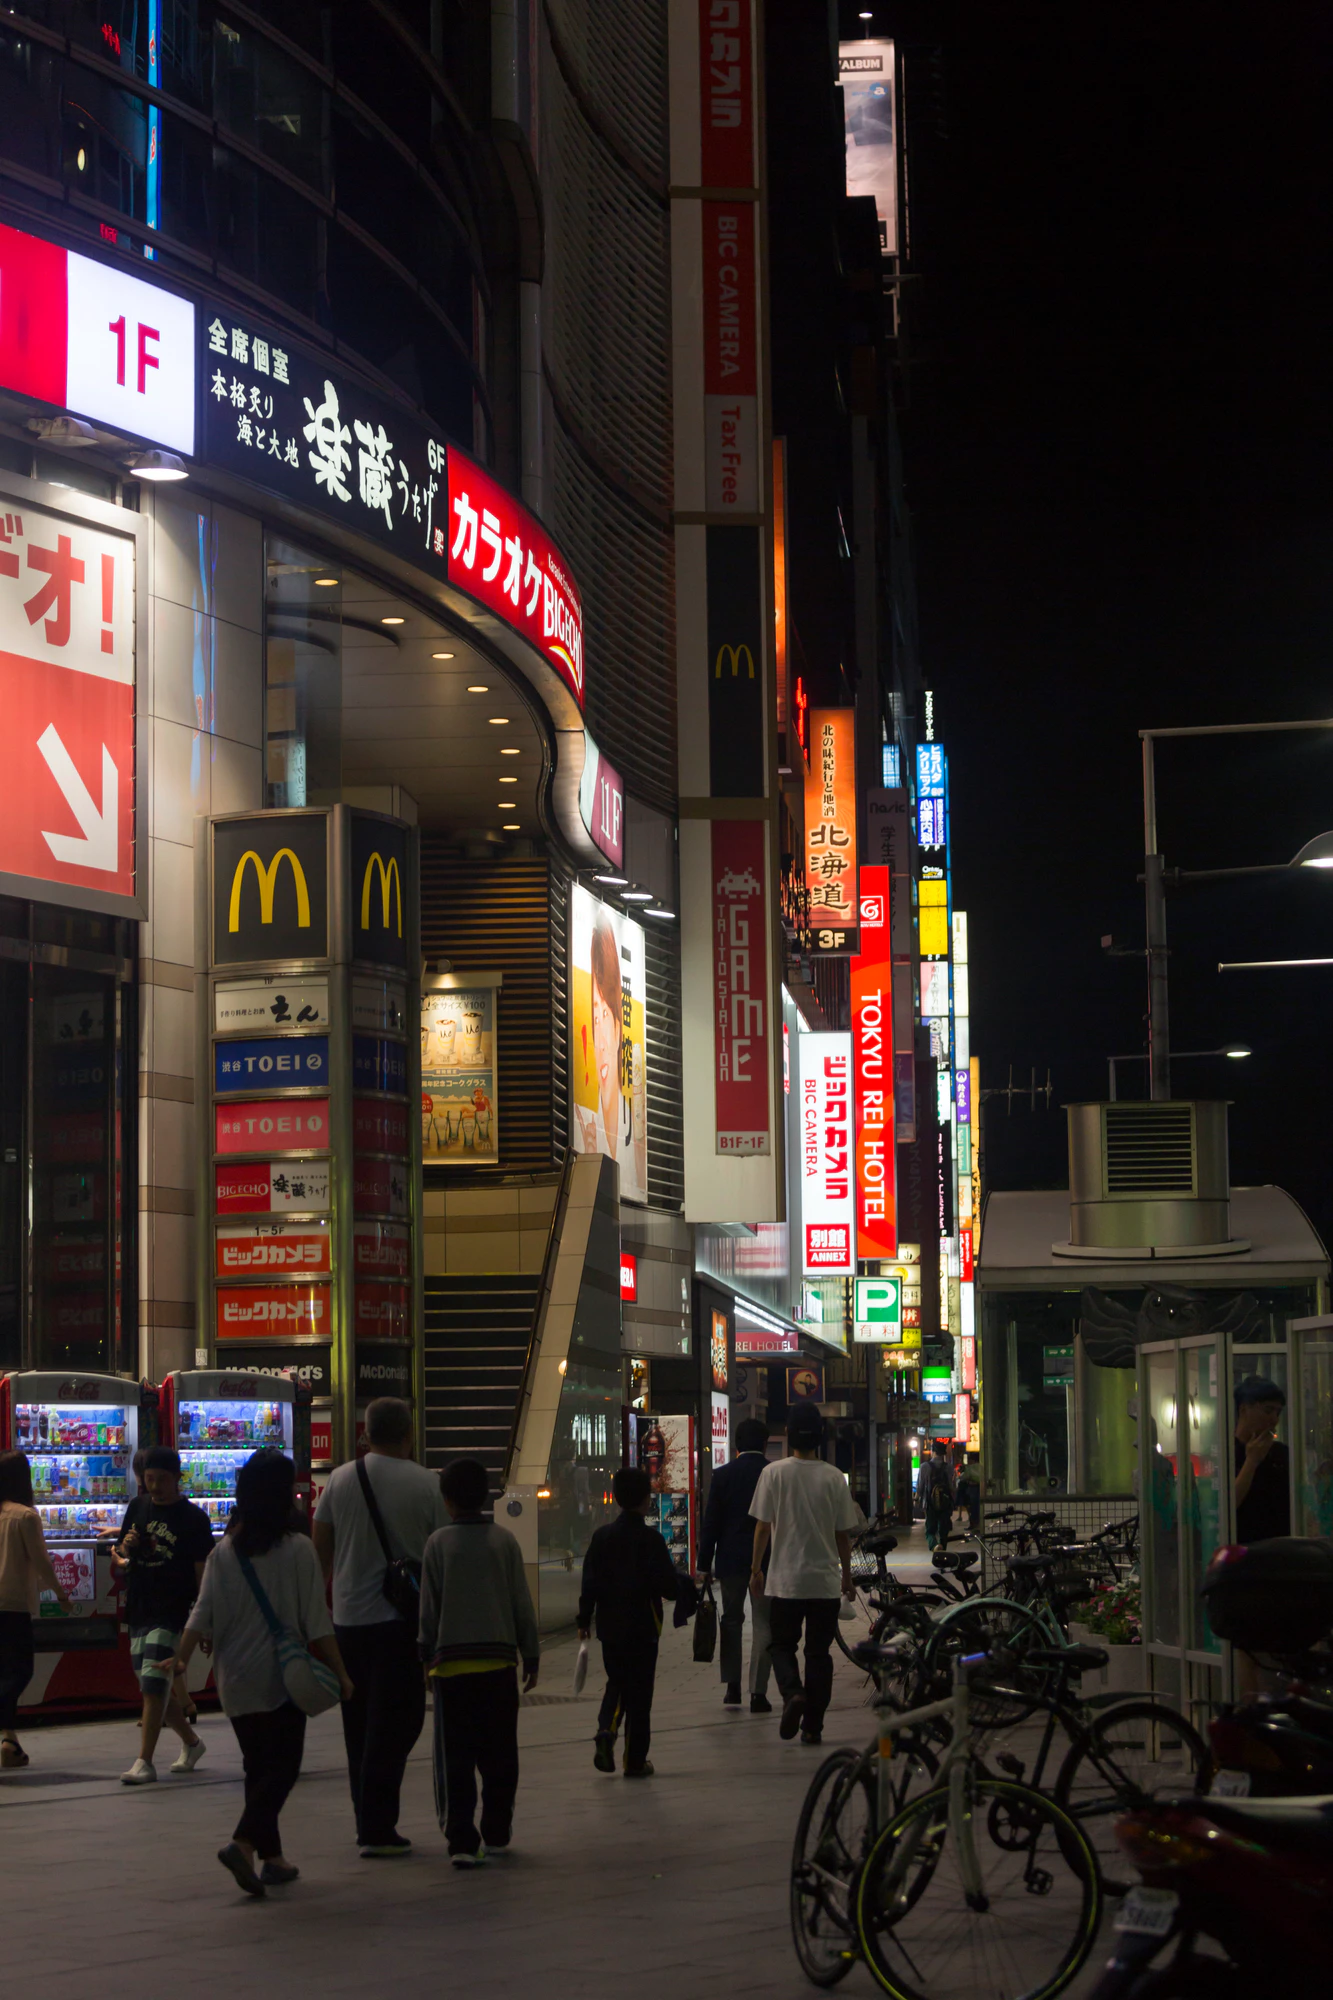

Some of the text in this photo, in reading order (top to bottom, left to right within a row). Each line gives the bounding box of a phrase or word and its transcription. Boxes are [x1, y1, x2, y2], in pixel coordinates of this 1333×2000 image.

[717, 216, 740, 378] BIC CAMERA
[109, 315, 160, 395] 1F
[208, 318, 290, 385] 全席個室
[210, 368, 274, 419] 本格炙り
[237, 414, 299, 468] 海と大地
[427, 438, 445, 474] 6F
[720, 405, 741, 504] Tax Free
[452, 492, 542, 617] カラオケ
[822, 724, 835, 817] 北の味紀行と地酒
[919, 751, 931, 796] クリニック
[931, 745, 942, 783] ヒラハタ
[810, 824, 851, 911] 北海道
[716, 904, 726, 976] TAITO
[818, 929, 845, 948] 3F
[270, 995, 319, 1023] えん
[222, 1060, 242, 1073] 渋谷
[244, 1055, 301, 1072] TOEI
[621, 945, 633, 1148] 一番搾り
[222, 1123, 241, 1134] 渋谷
[245, 1116, 302, 1134] TOEI
[805, 1080, 818, 1177] BIC CAMERA
[824, 1055, 848, 1199] ビックカメラ
[860, 988, 885, 1227] TOKYU REI HOTEL
[720, 1136, 764, 1149] B1F-1F
[223, 1244, 322, 1266] ビックカメラ
[810, 1229, 846, 1248] 別館
[810, 1251, 846, 1263] ANNEX
[224, 1300, 323, 1322] ビックカメラ
[858, 1281, 897, 1322] P
[756, 1340, 794, 1351] HOTEL
[859, 1324, 895, 1337] 有料
